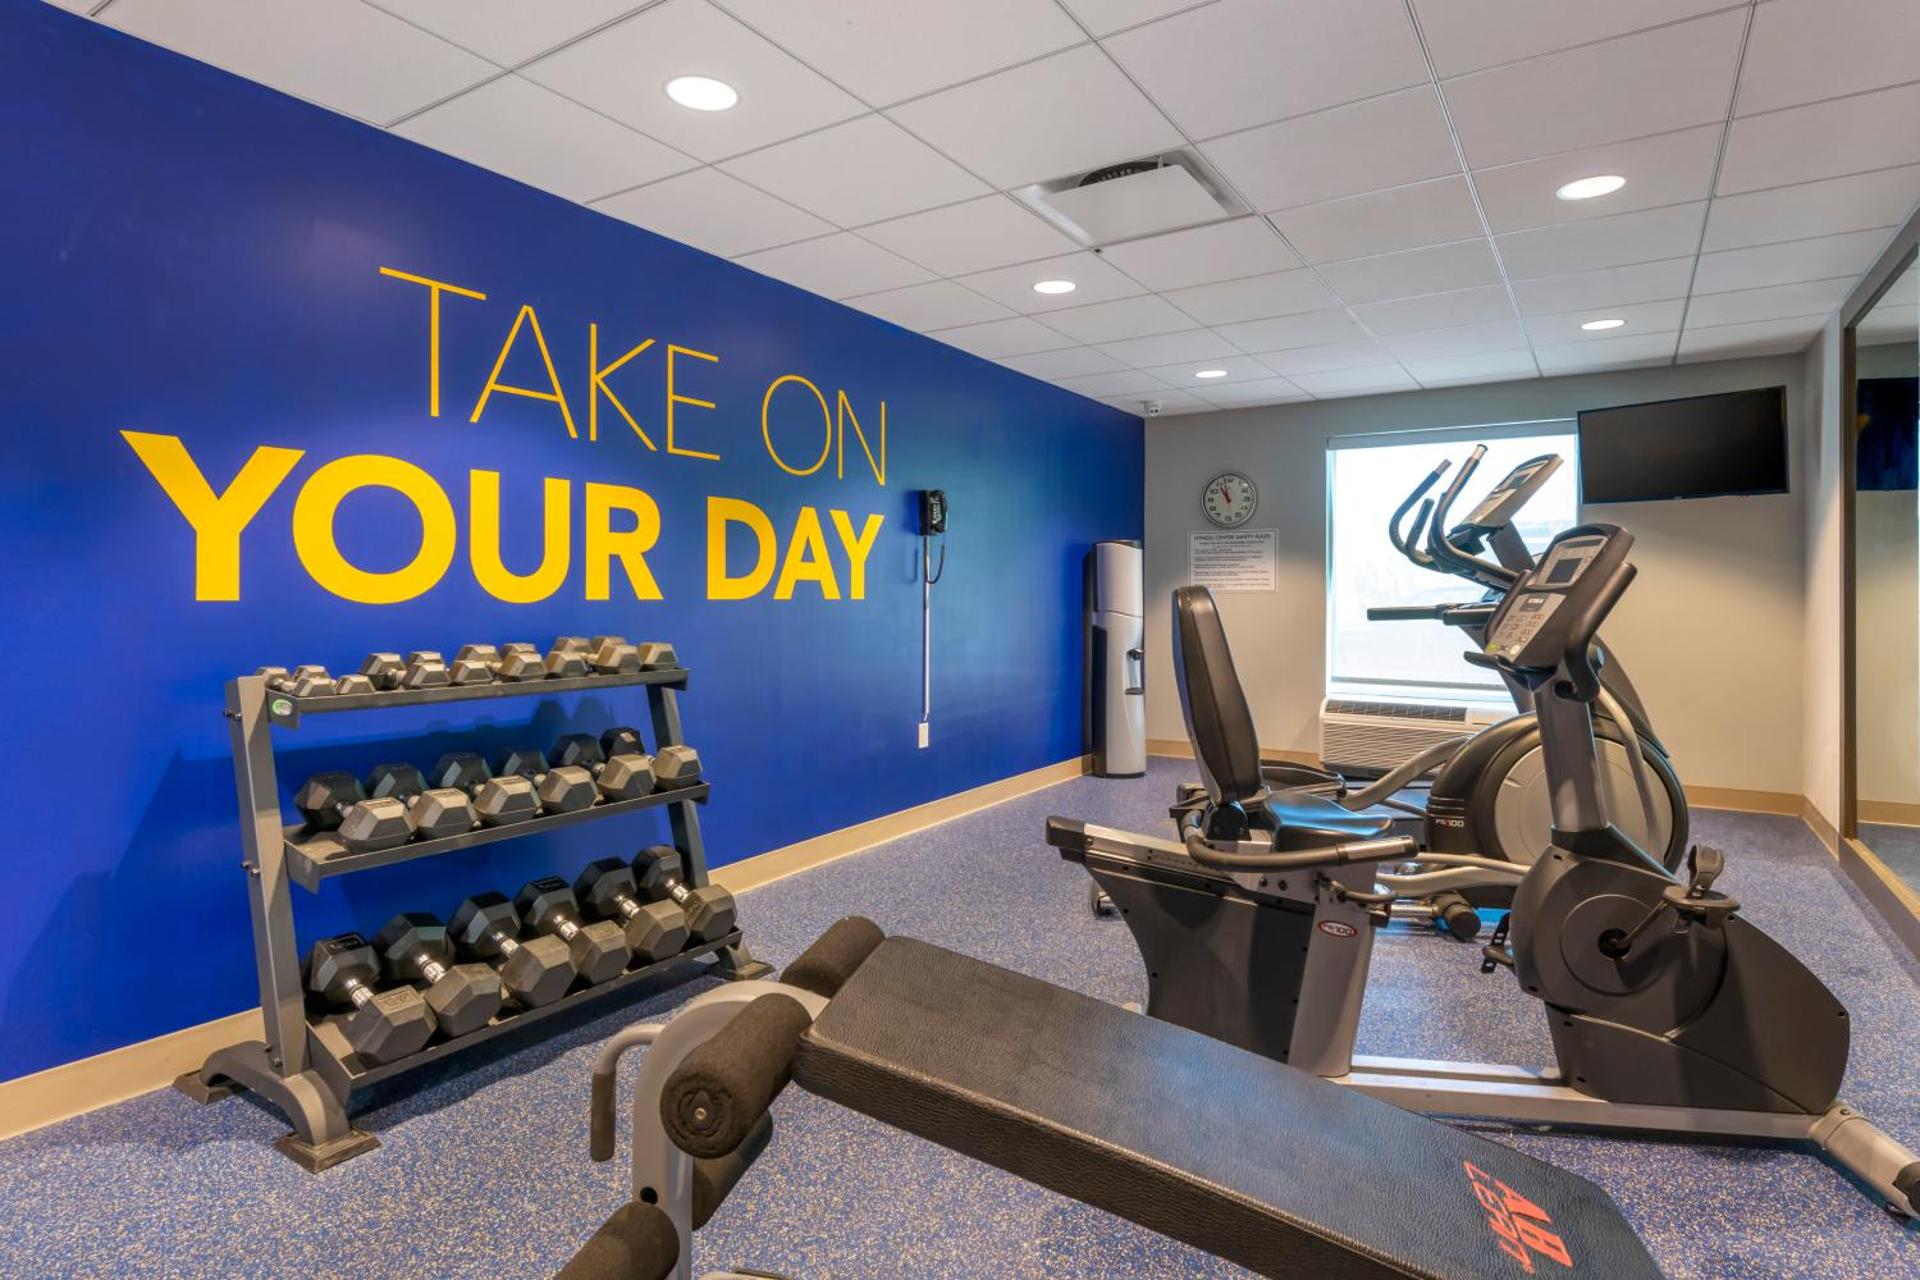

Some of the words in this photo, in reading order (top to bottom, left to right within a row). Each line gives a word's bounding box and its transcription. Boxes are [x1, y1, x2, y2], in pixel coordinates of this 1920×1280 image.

[379, 266, 721, 461] TAKE
[762, 374, 887, 486] ON
[120, 430, 664, 605] YOUR
[706, 496, 885, 602] DAY
